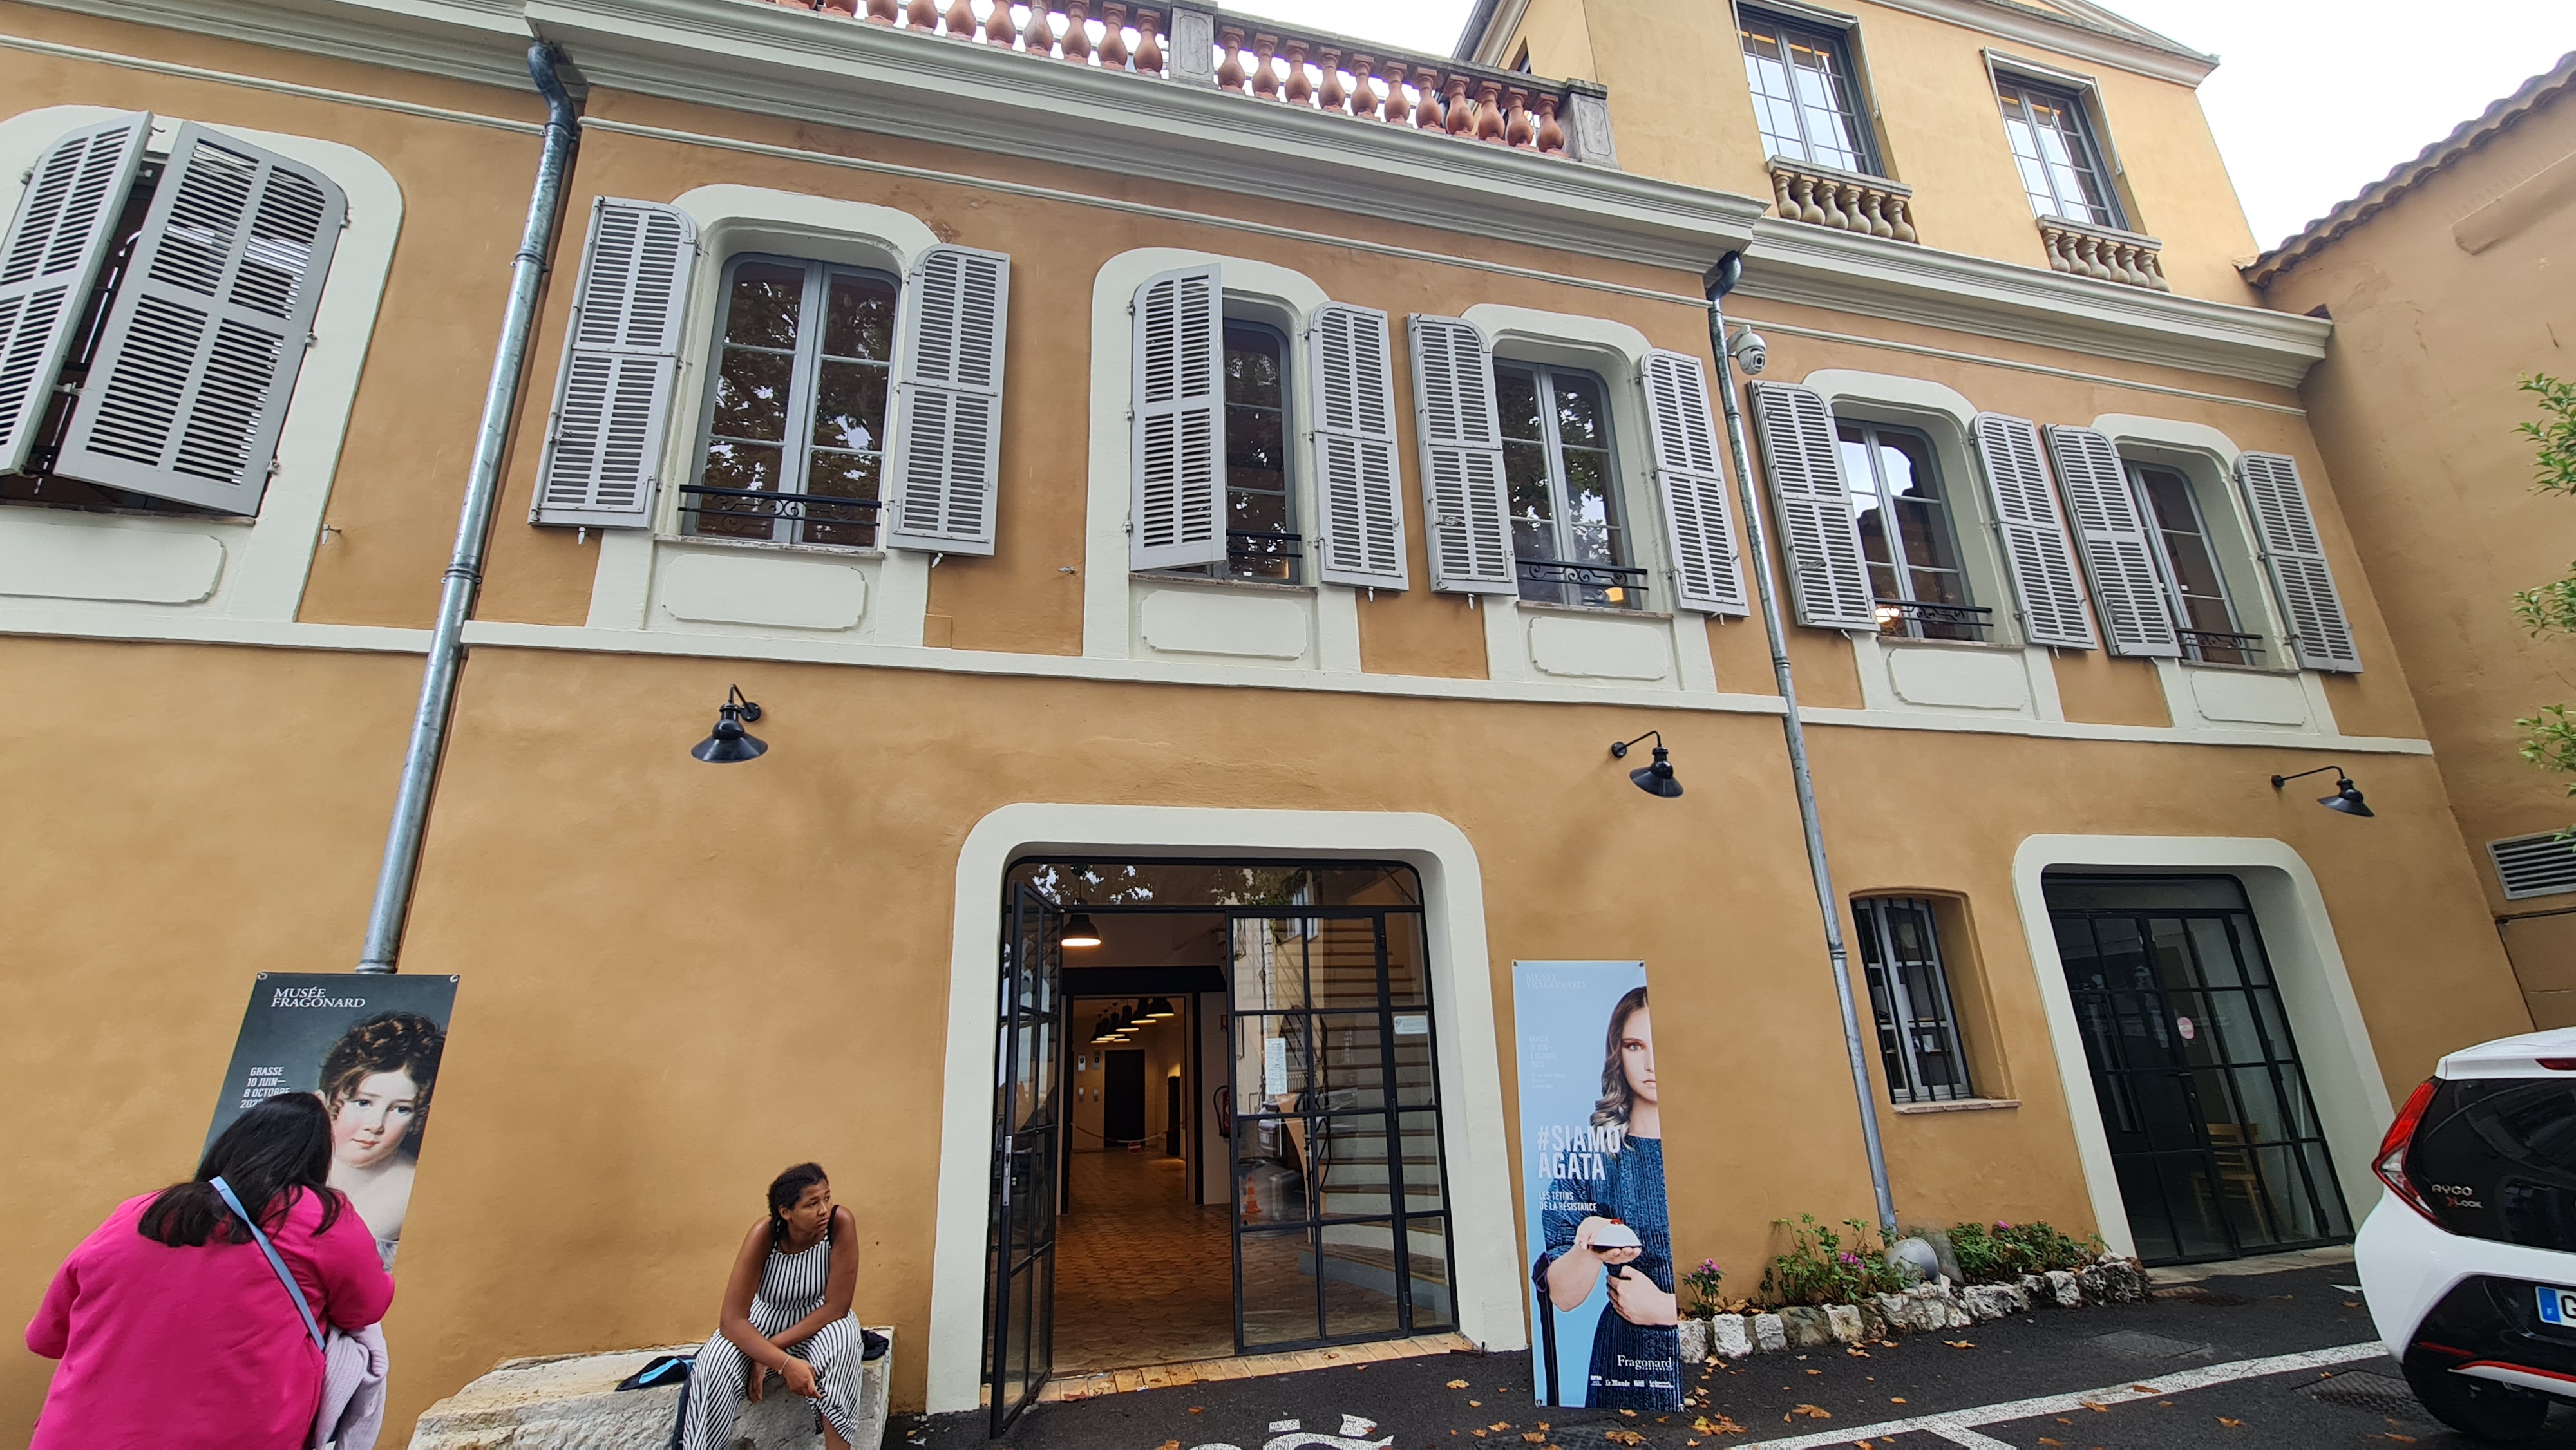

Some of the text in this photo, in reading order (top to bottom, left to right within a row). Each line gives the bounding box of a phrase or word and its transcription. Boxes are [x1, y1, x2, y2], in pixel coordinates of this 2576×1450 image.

[1526, 981, 1586, 989] FRAGONARD
[274, 986, 327, 997] MUSÉE
[271, 997, 366, 1008] FRAGONARD
[250, 1066, 284, 1076] GRASSE
[247, 1078, 258, 1087] 10
[243, 1088, 251, 1097] 8
[1537, 1125, 1621, 1153] #SIAMO
[1538, 1152, 1606, 1180] AGATA
[1539, 1191, 1550, 1200] LES
[2432, 1184, 2473, 1196] AYGO
[1539, 1200, 1597, 1211] DE LA RÉSISTANCE
[1617, 1355, 1672, 1370] Fragonard
